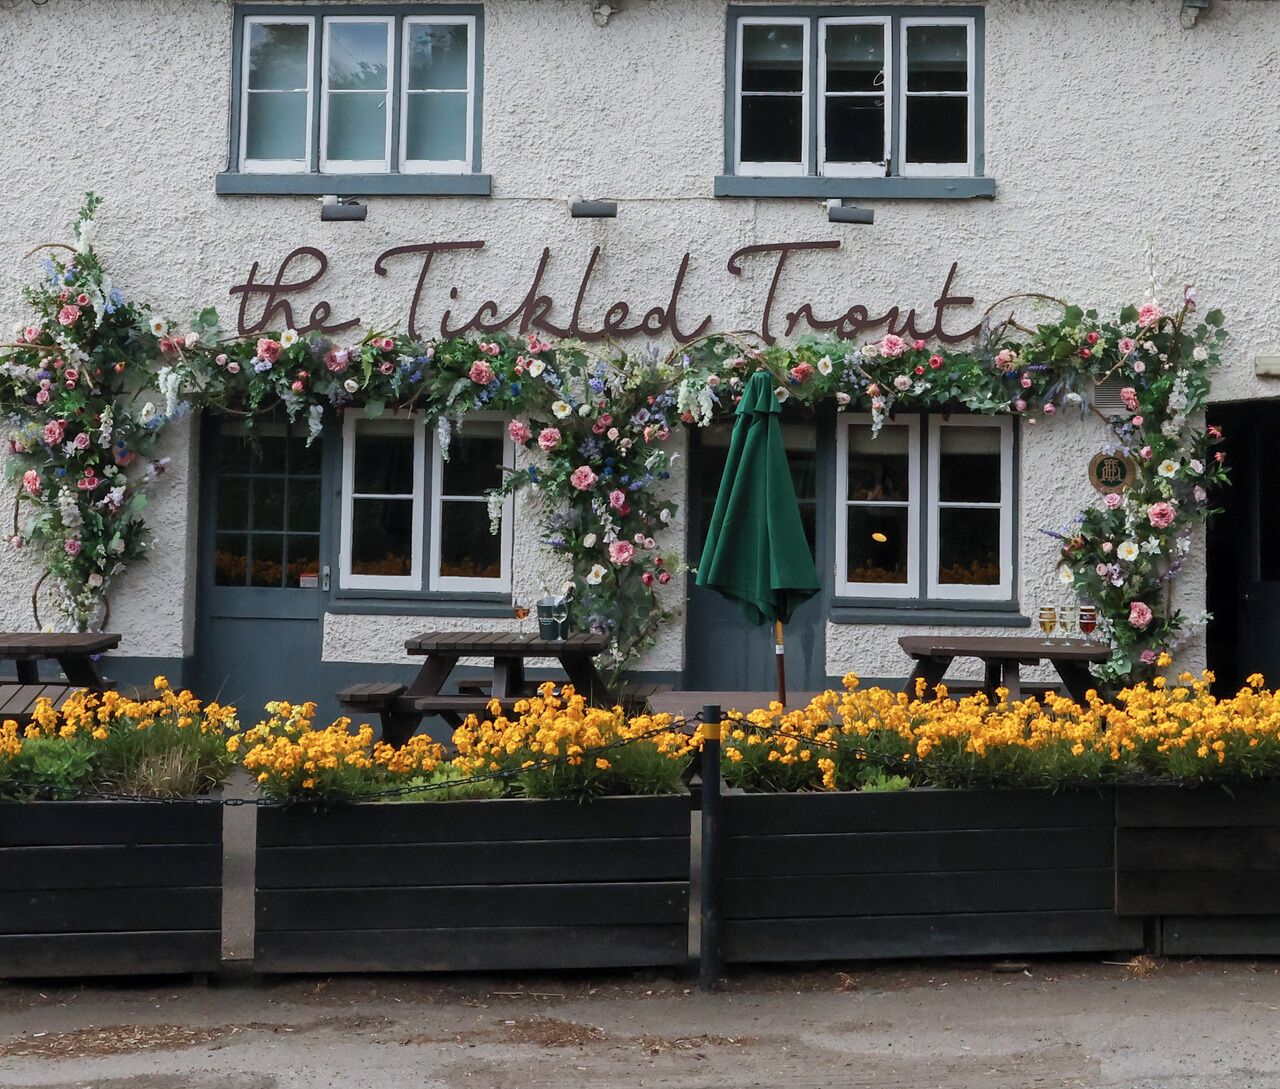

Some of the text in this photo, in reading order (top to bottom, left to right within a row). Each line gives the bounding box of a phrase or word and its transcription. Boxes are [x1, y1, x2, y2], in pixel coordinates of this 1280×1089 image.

[229, 241, 983, 345] the Tickled Trout
